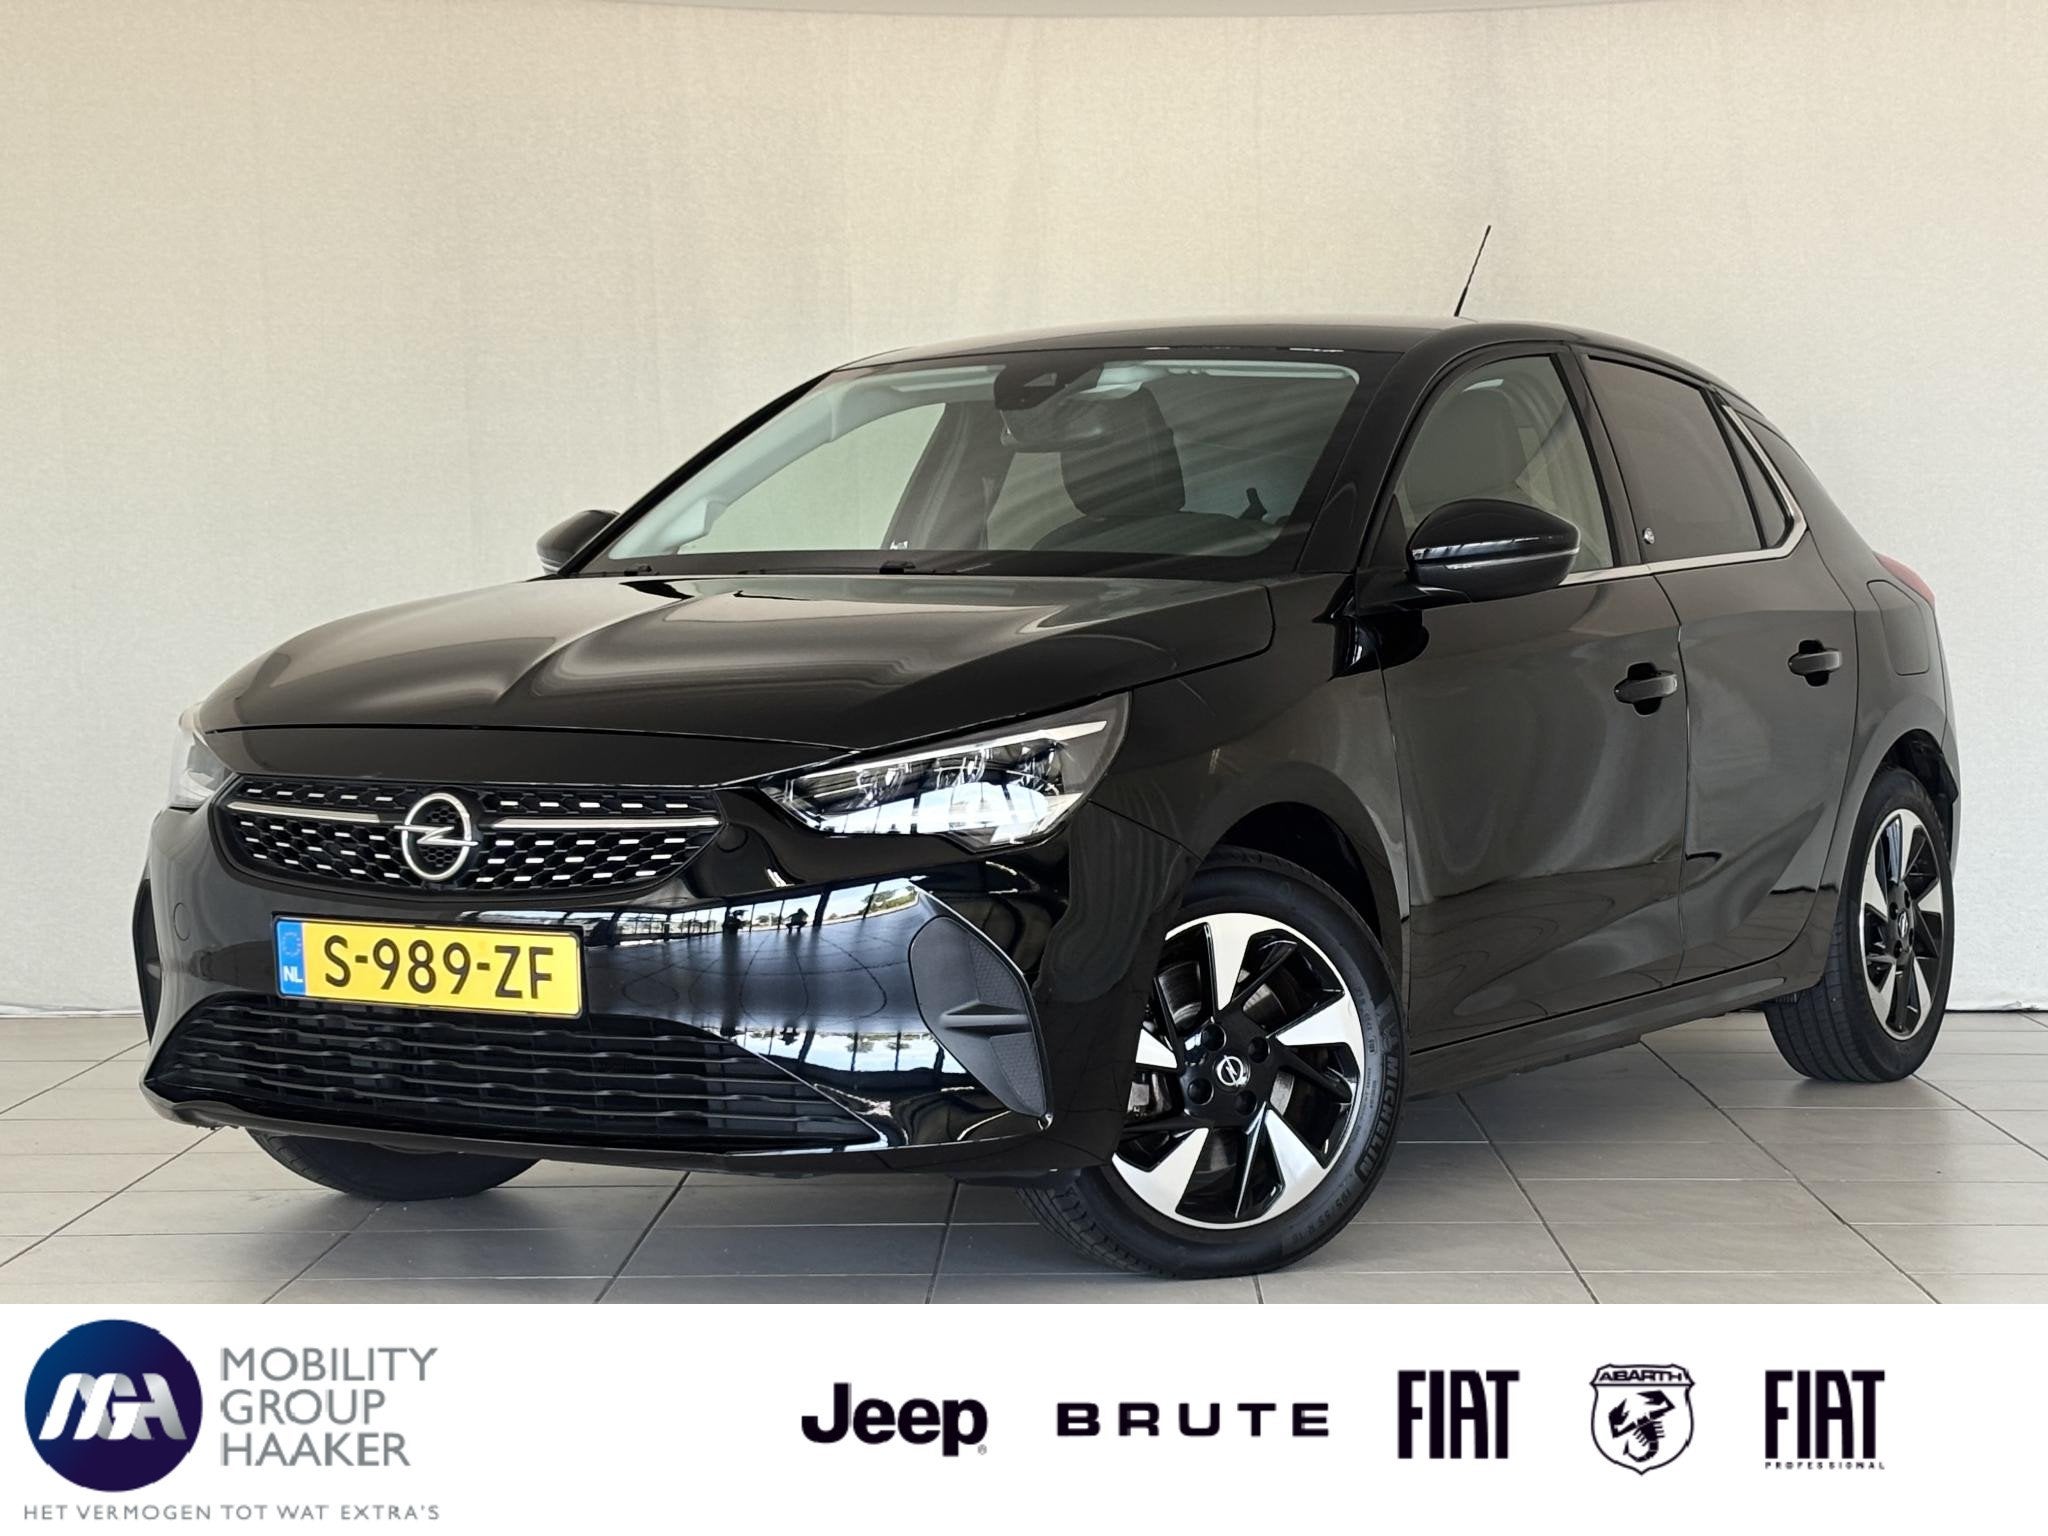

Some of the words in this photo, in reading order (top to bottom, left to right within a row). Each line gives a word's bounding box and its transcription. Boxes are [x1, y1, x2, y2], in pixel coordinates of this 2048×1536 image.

[283, 965, 303, 983] NL
[323, 934, 554, 1000] S-989-ZF
[1358, 1055, 1399, 1178] MICHELIN
